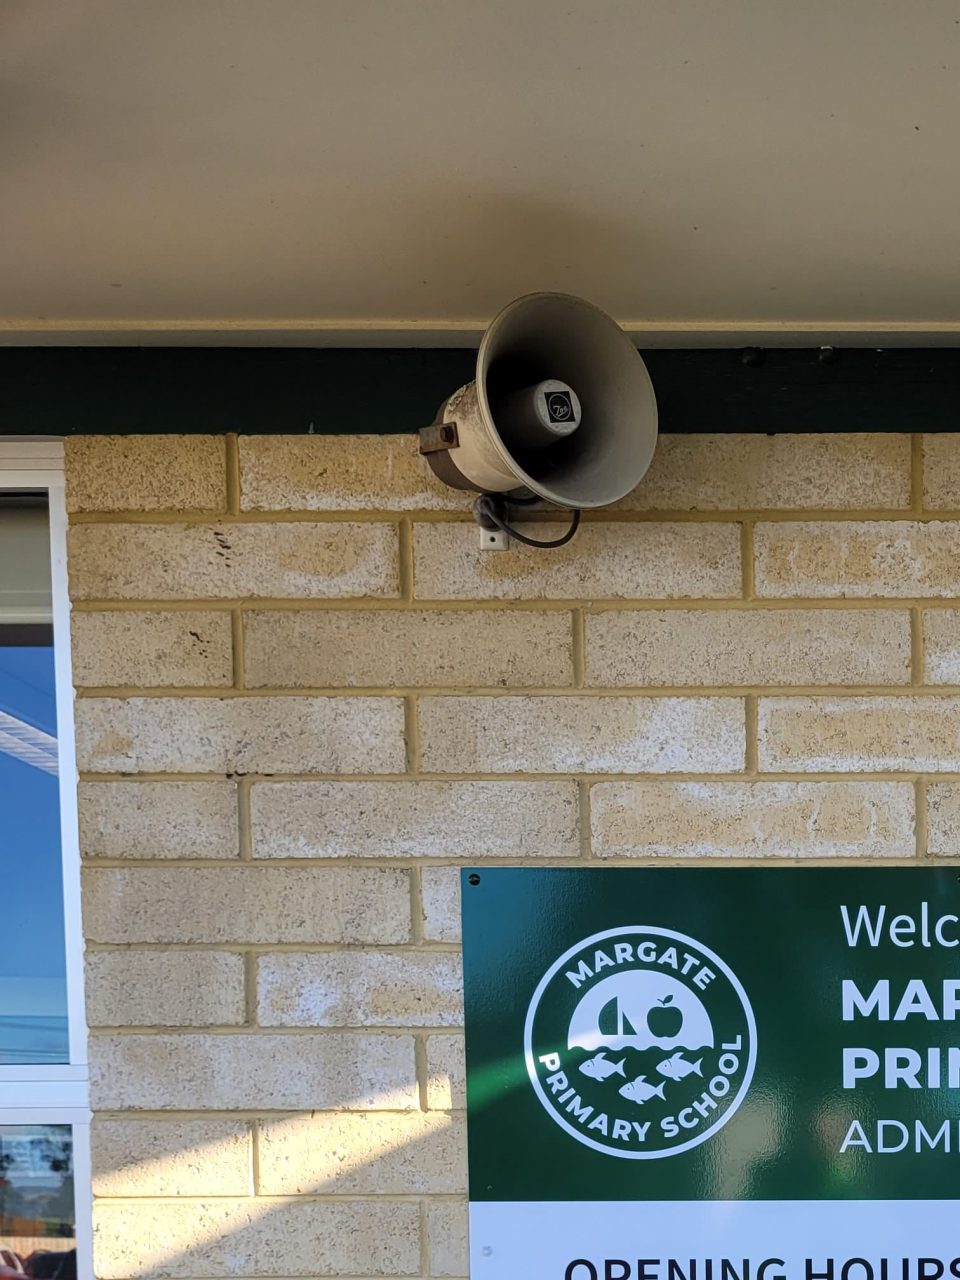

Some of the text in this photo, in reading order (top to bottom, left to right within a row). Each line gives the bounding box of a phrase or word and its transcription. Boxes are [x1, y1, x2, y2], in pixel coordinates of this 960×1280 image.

[565, 941, 717, 991] MARGATE
[538, 1034, 743, 1143] PRIMARY SCHOOL
